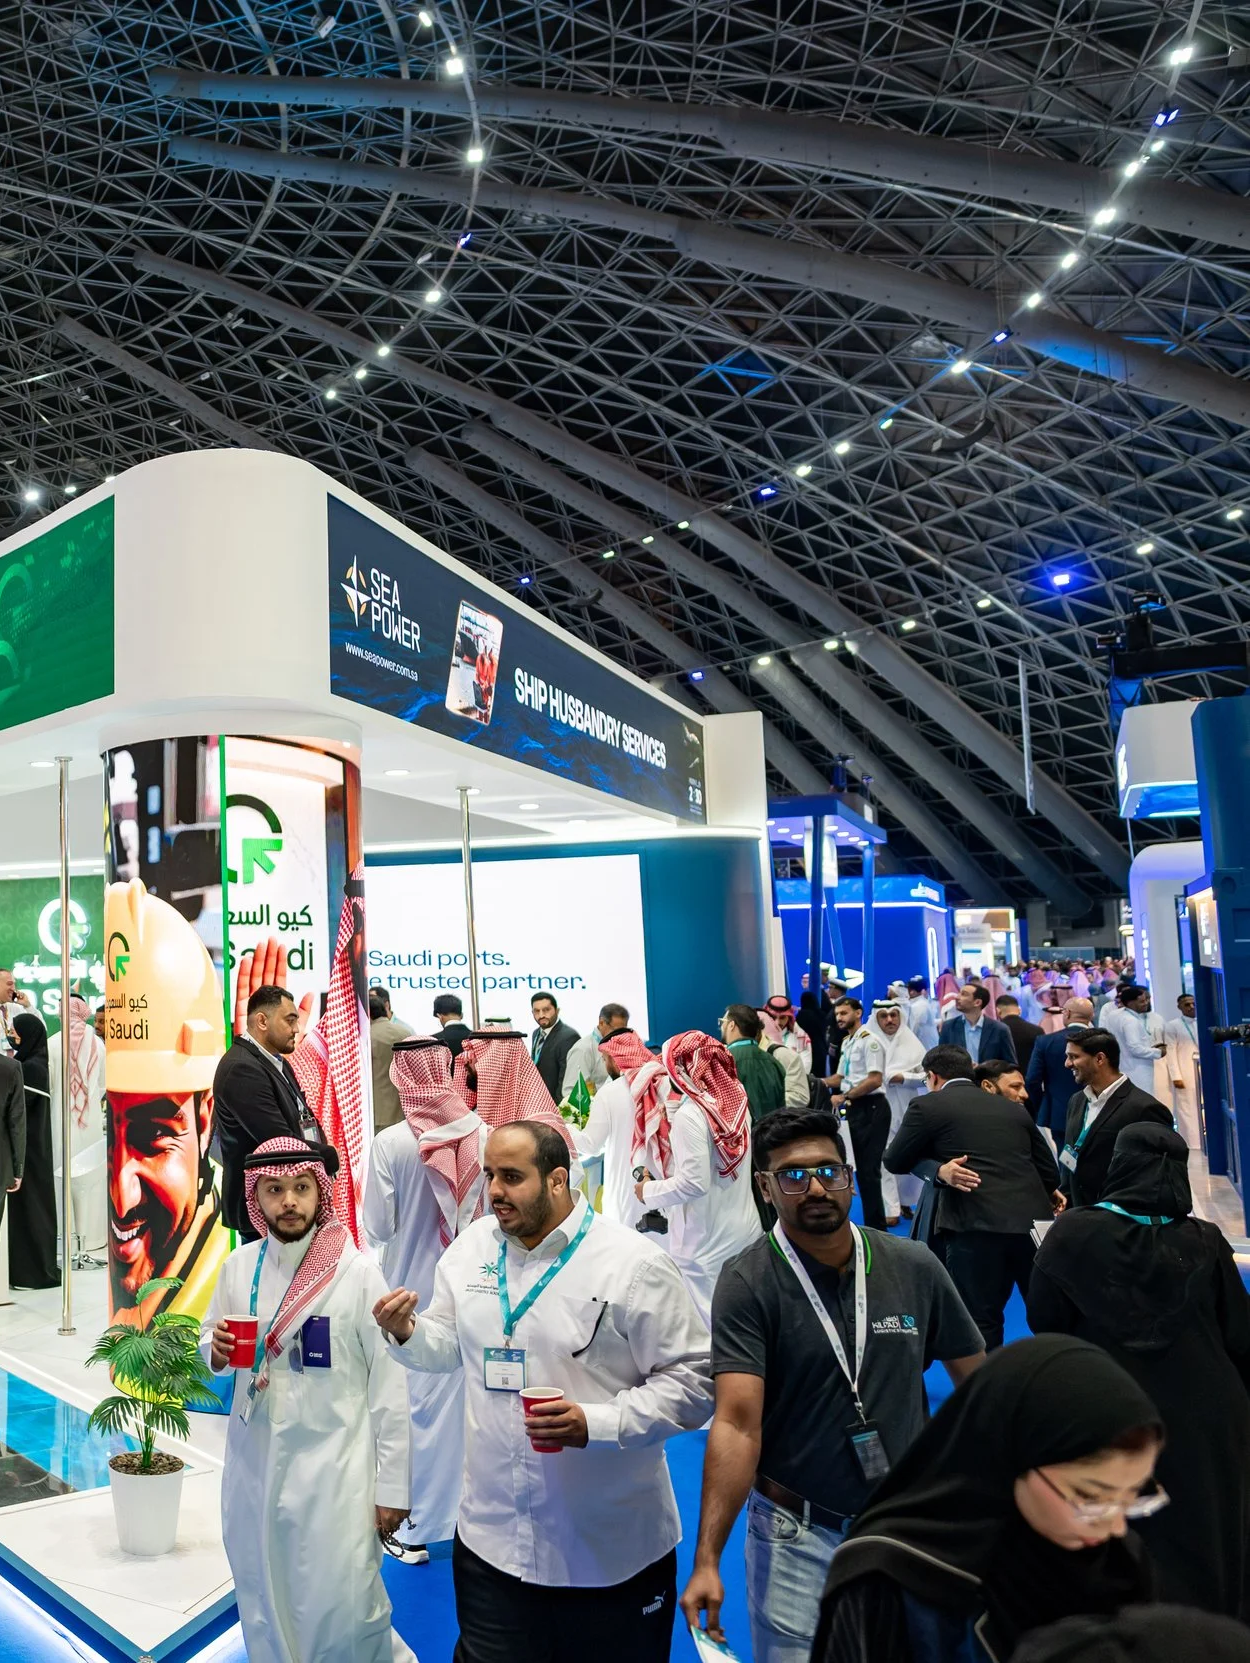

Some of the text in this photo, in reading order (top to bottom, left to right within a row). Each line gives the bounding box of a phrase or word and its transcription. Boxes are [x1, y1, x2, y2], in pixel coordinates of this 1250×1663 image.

[370, 568, 401, 612] SEA
[372, 601, 421, 654] POWER
[345, 642, 418, 681] www.seapower.com.sa
[514, 667, 667, 770] SHIP HUSBANDRY SERVICES
[277, 905, 313, 931] كيو
[369, 950, 510, 970] Saudi pots.
[482, 974, 586, 993] partner.
[129, 994, 148, 1012] كيو
[110, 1018, 148, 1040] Saudi
[642, 1600, 662, 1615] PUMA
